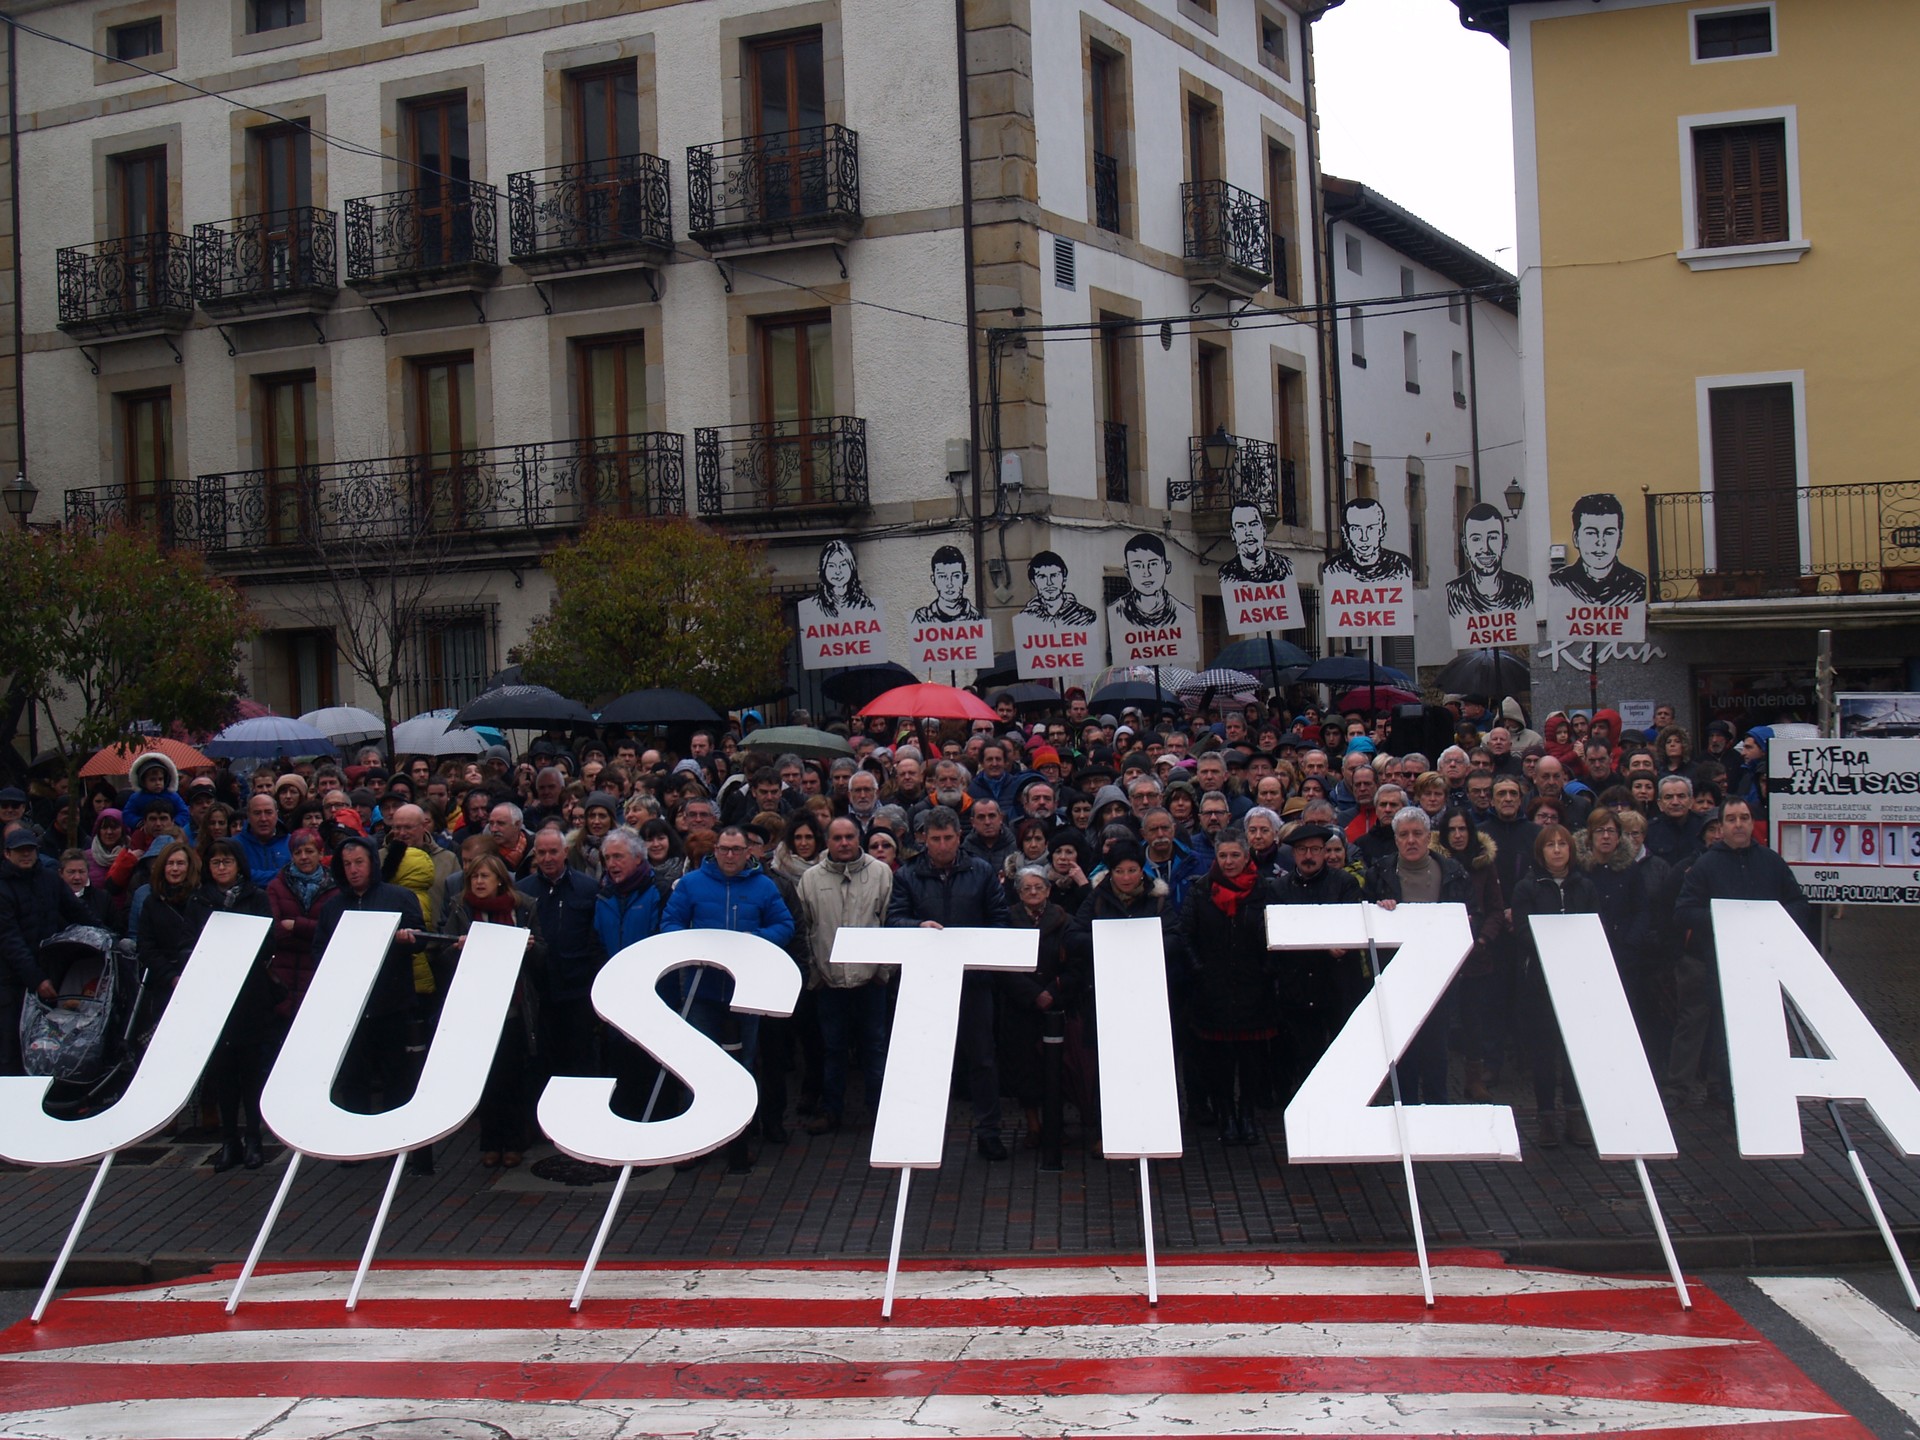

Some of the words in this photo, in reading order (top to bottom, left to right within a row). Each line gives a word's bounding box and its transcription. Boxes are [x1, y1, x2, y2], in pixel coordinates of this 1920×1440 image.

[1233, 584, 1286, 603] IÑAKI
[1330, 587, 1403, 605] ARATZ
[1239, 605, 1289, 624] ASKE
[1338, 611, 1395, 626] ASKE
[1466, 612, 1517, 630] ADUR
[1566, 606, 1629, 620] JOKIN
[806, 619, 881, 639] AINARA
[913, 624, 984, 643] JONAN
[1125, 627, 1182, 644] OIHAN
[1469, 628, 1518, 644] ASKE
[1569, 622, 1623, 636] ASKE
[819, 640, 871, 657] ASKE
[1022, 632, 1088, 649] JULEN
[923, 646, 977, 662] ASKE
[1031, 652, 1085, 669] ASKE
[1130, 644, 1178, 660] ASKE
[1788, 746, 1870, 766] ETXERA
[1790, 769, 1920, 793] #ALTSAS
[1814, 871, 1839, 881] egun
[0, 899, 1920, 1166] JUSTIZIA
